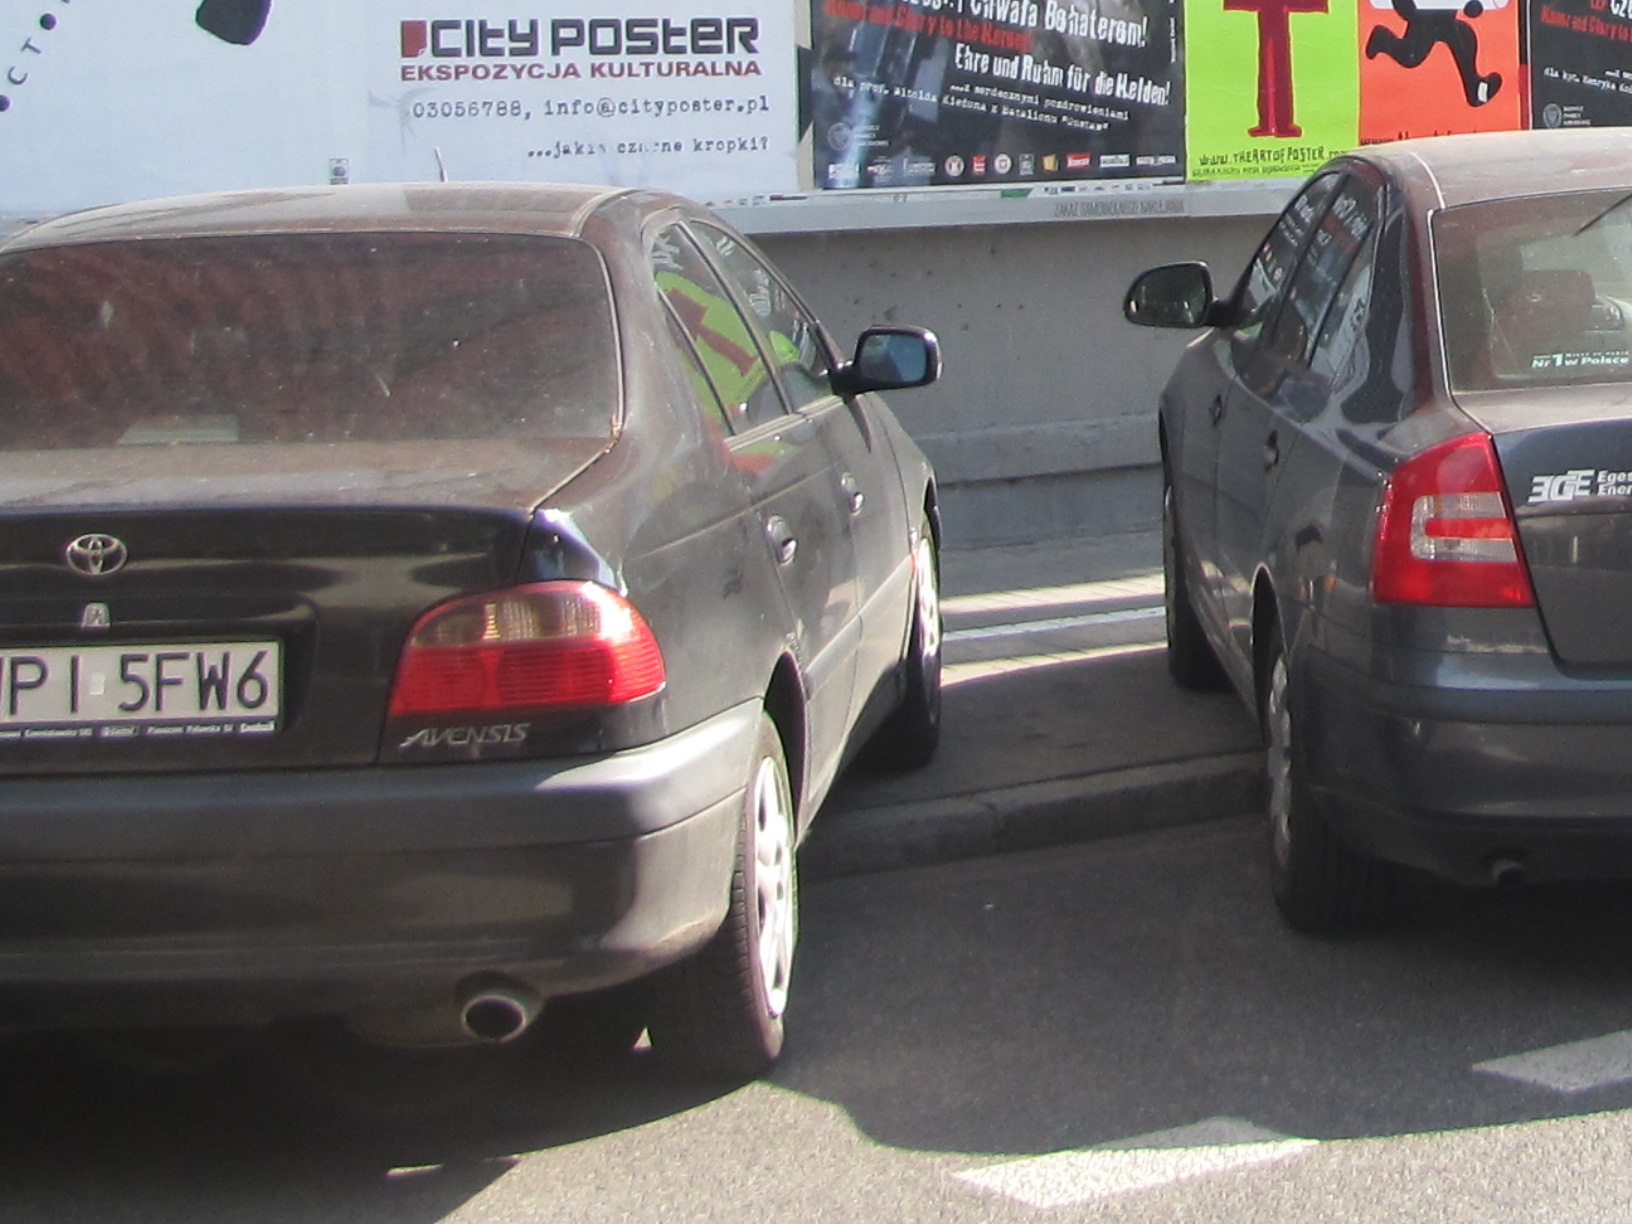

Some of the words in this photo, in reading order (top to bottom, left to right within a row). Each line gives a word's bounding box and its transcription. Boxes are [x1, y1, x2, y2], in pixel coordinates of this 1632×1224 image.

[1044, 0, 1148, 48] Bohaterom!
[400, 63, 581, 82] EKSPOZYCJA
[590, 60, 762, 78] KULTURALNA
[955, 43, 988, 74] Ehre
[993, 51, 1019, 79] und
[1021, 54, 1064, 87] Ruhm
[1067, 64, 1092, 92] für
[1095, 70, 1114, 96] die
[1116, 73, 1171, 106] Helden!
[410, 101, 532, 120] 03056788,
[544, 95, 770, 118] info@cityposter.pl
[1552, 353, 1564, 366] 1
[1580, 356, 1629, 367] Polsce
[118, 650, 270, 712] 5FW6
[398, 723, 532, 748] AVENSIS
